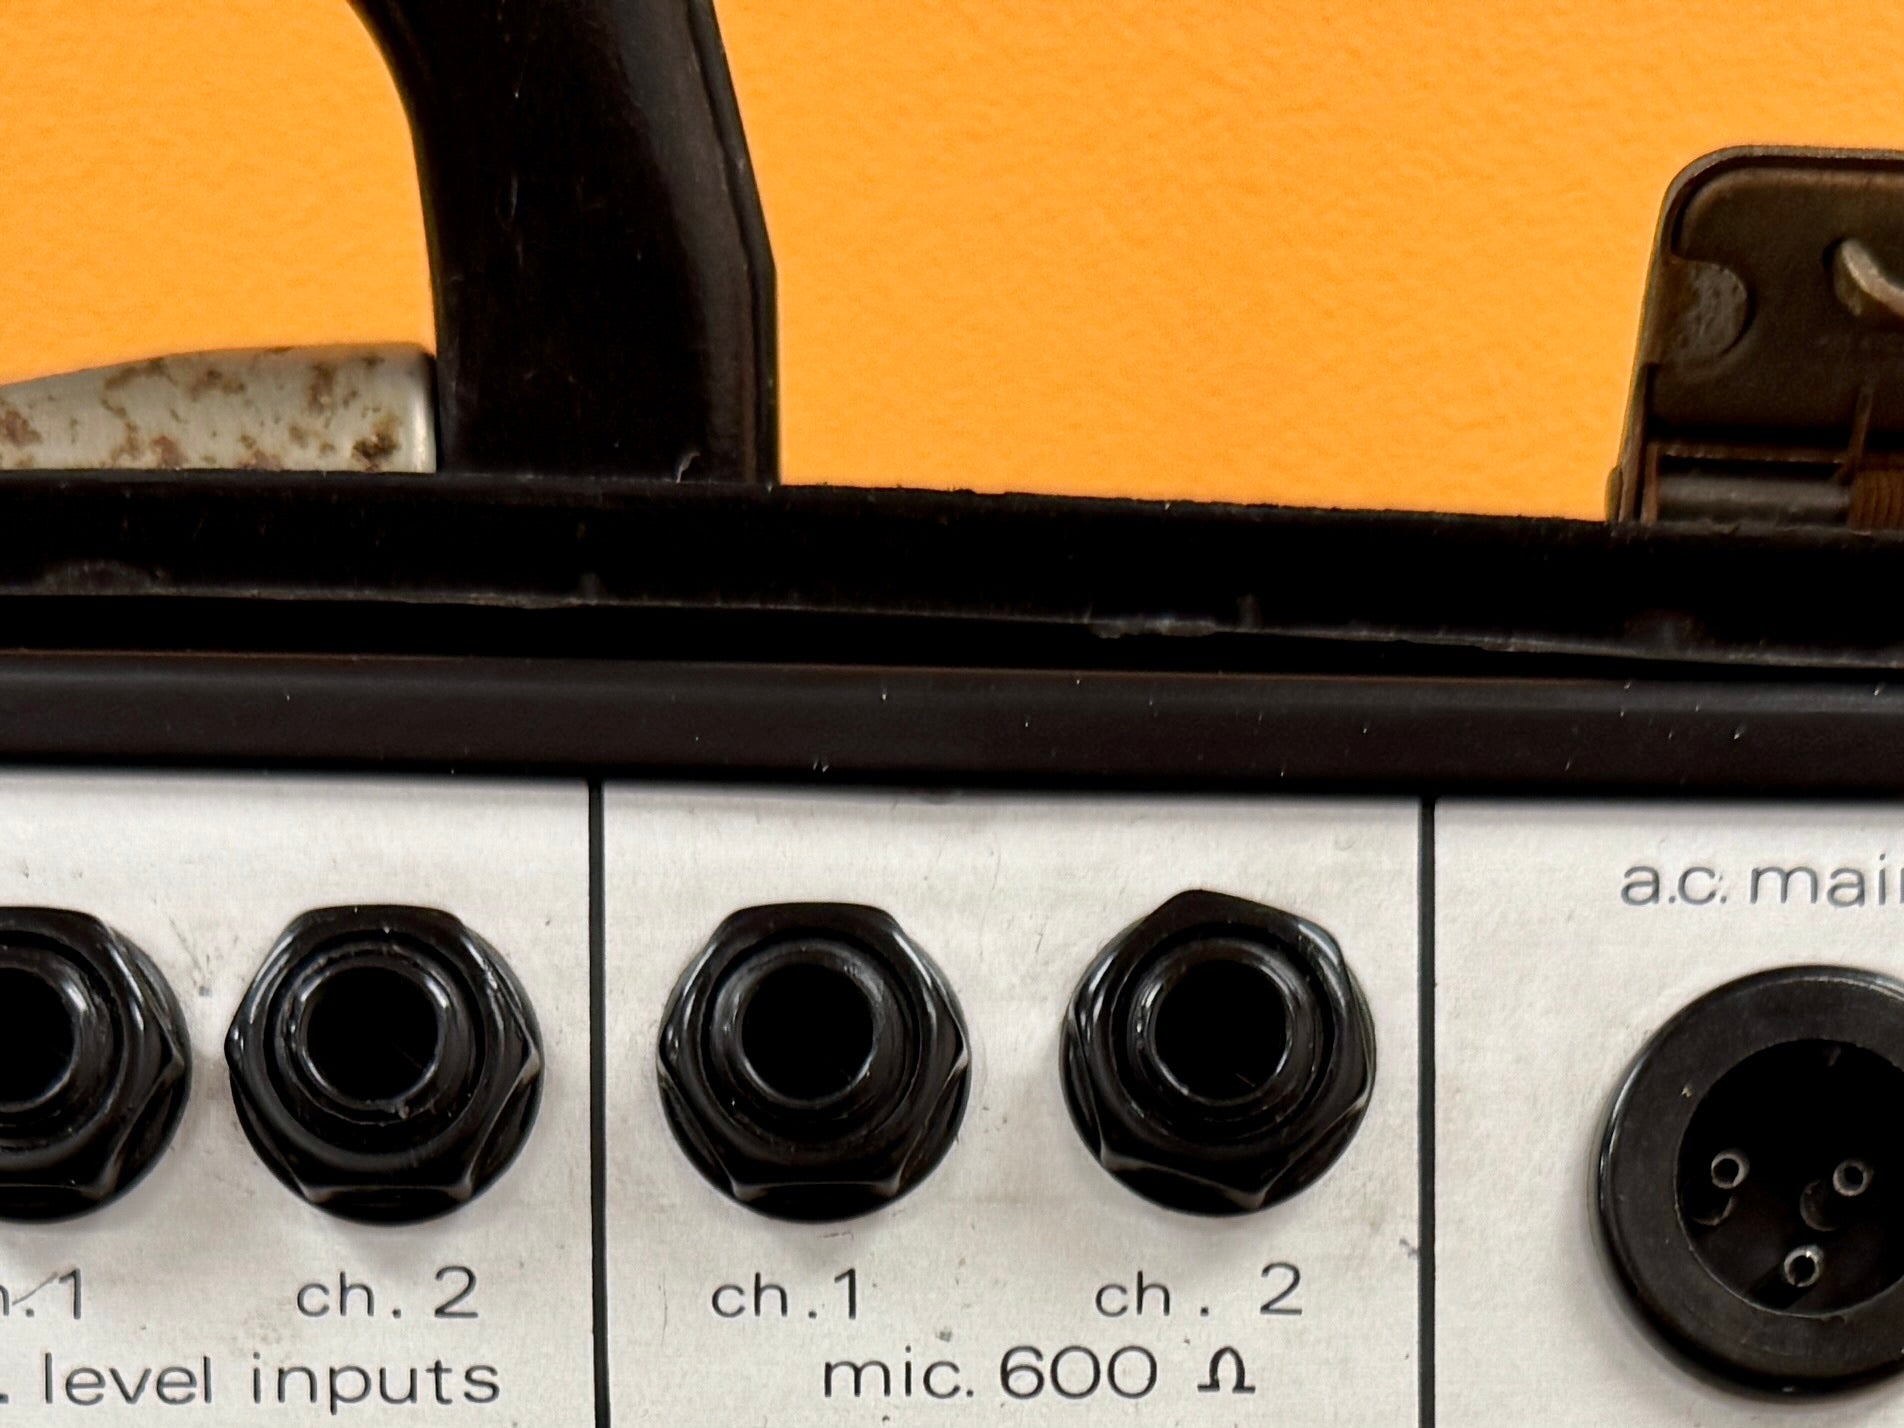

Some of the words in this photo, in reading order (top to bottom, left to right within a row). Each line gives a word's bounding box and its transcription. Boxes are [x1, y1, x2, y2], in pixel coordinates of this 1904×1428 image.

[44, 1352, 212, 1406] level
[253, 1351, 500, 1416] inputs
[824, 1344, 974, 1399] mic.
[1000, 1343, 1157, 1400] 600
